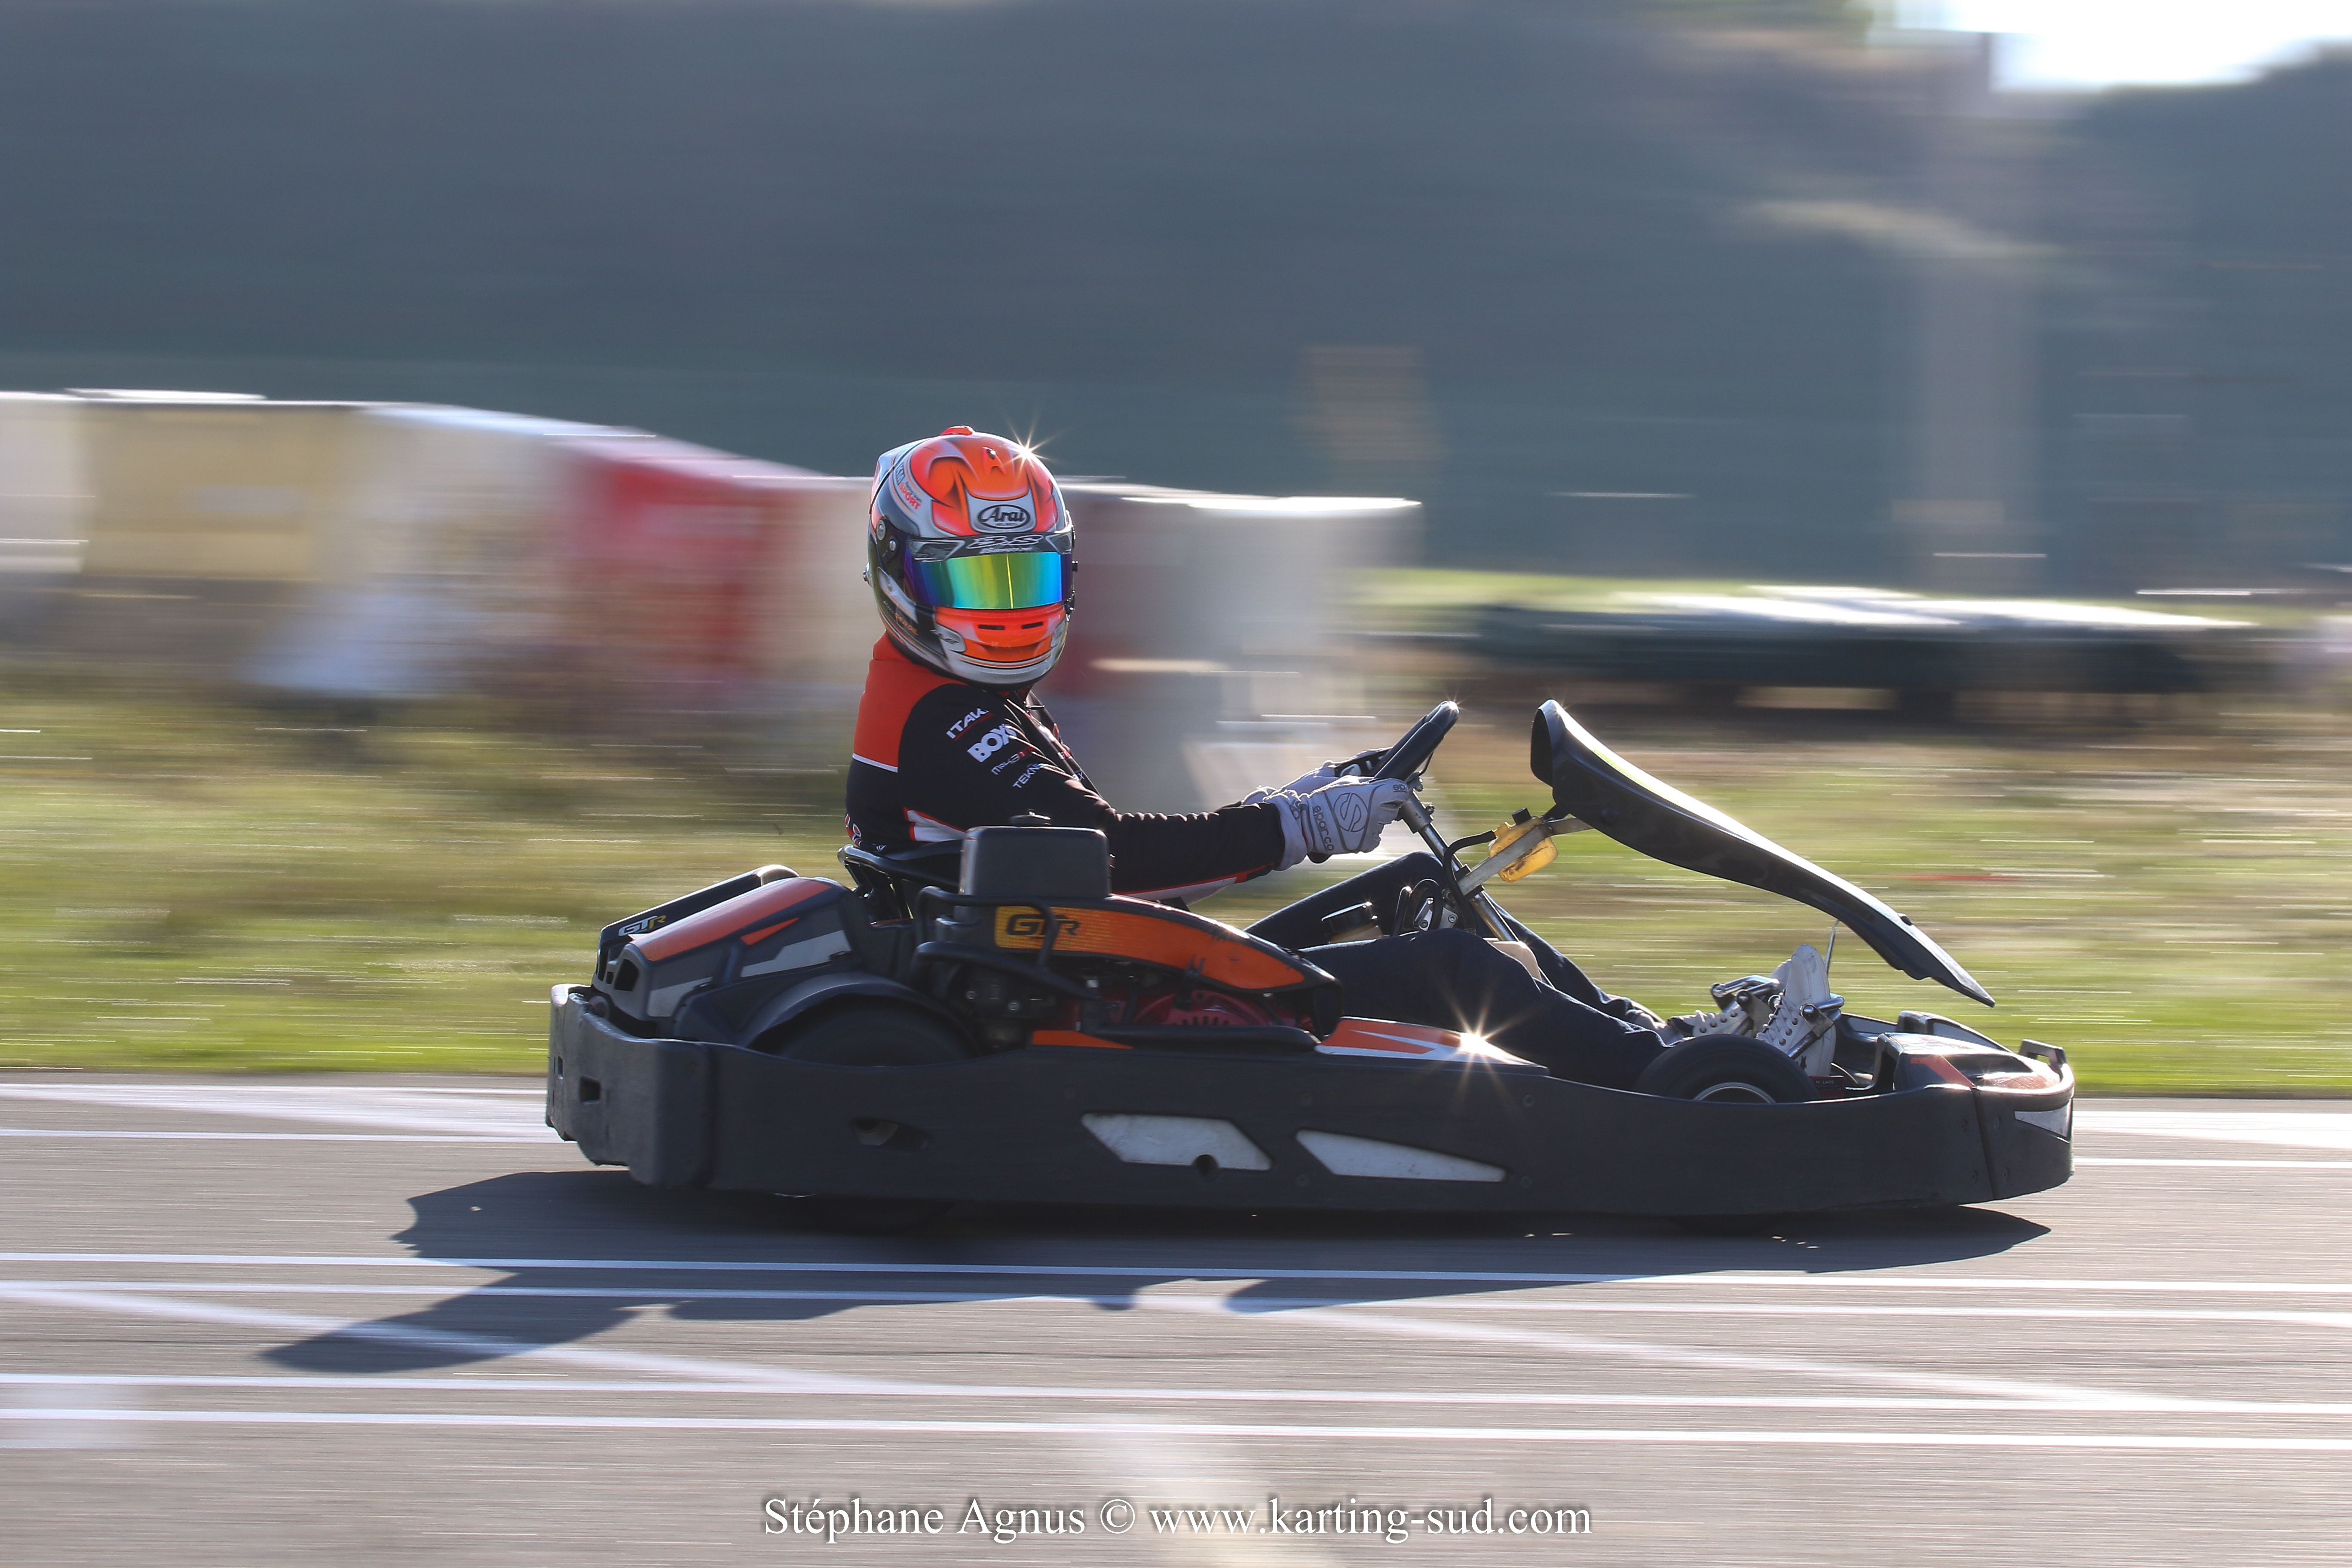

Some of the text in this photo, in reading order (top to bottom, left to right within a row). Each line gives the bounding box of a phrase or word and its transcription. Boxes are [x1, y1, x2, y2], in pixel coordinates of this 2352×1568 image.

[981, 507, 1026, 522] Arai
[1312, 805, 1334, 852] sparco
[618, 915, 667, 936] GTR
